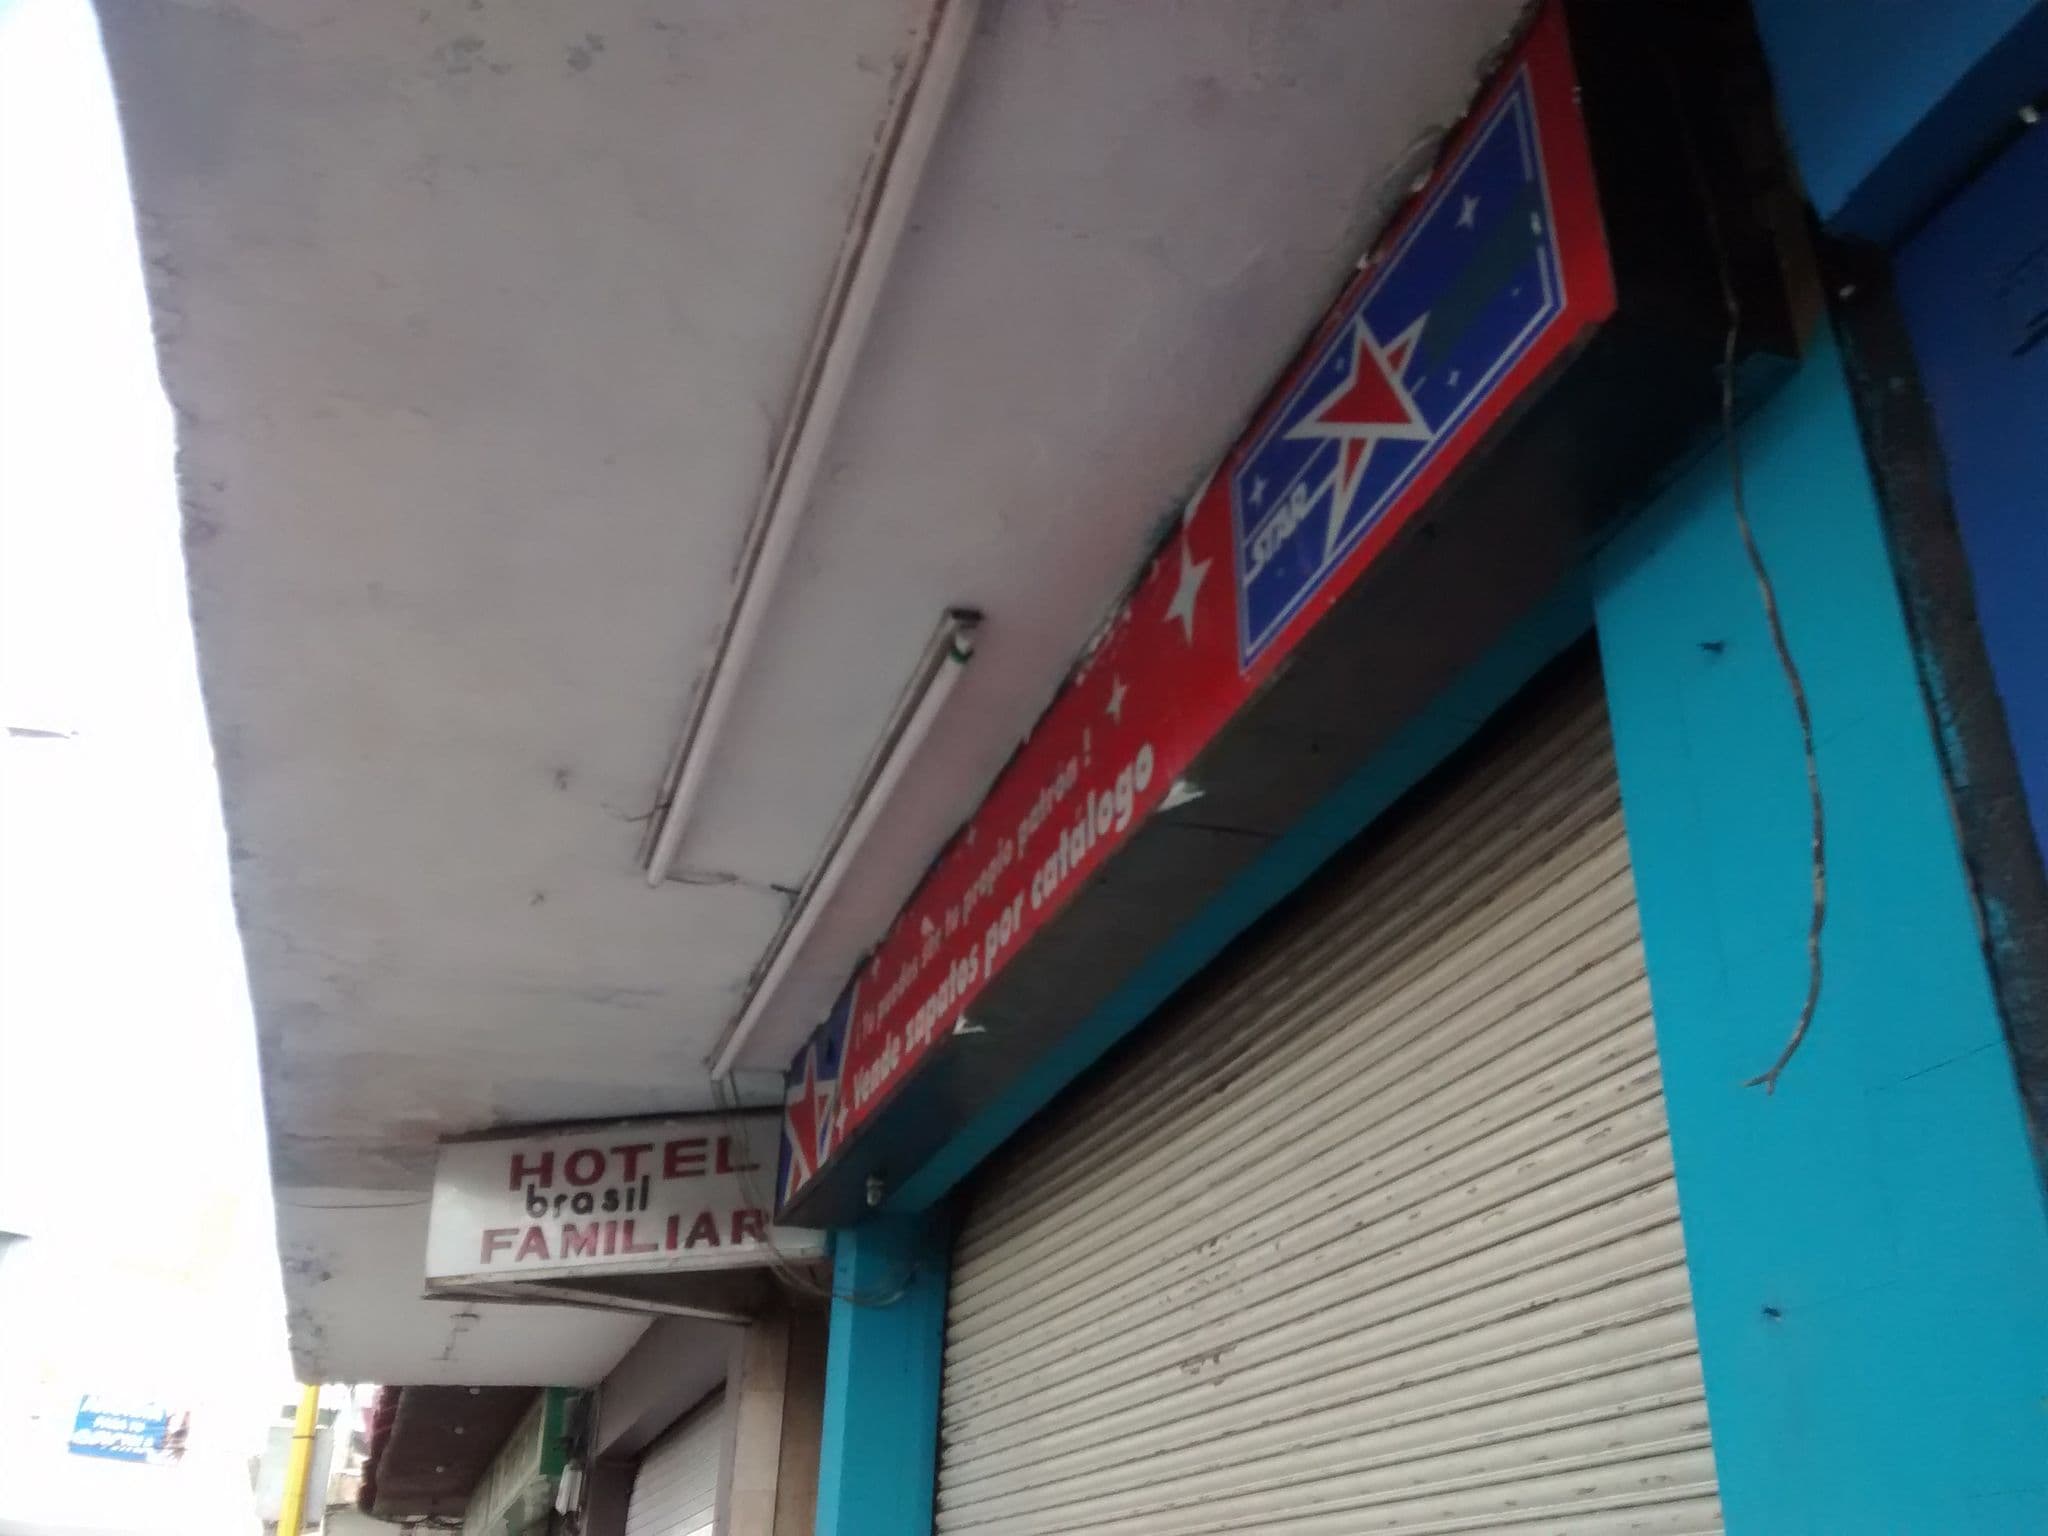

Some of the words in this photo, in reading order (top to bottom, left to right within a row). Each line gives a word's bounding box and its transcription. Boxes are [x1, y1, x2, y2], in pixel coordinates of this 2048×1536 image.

[1252, 480, 1309, 567] STAR
[853, 1031, 900, 1110] Vende
[905, 943, 979, 1054] zapatos
[984, 890, 1024, 979] por
[508, 1135, 760, 1191] HOTEL
[525, 1175, 650, 1219] brasil
[479, 1207, 769, 1265] FAMILIAR
